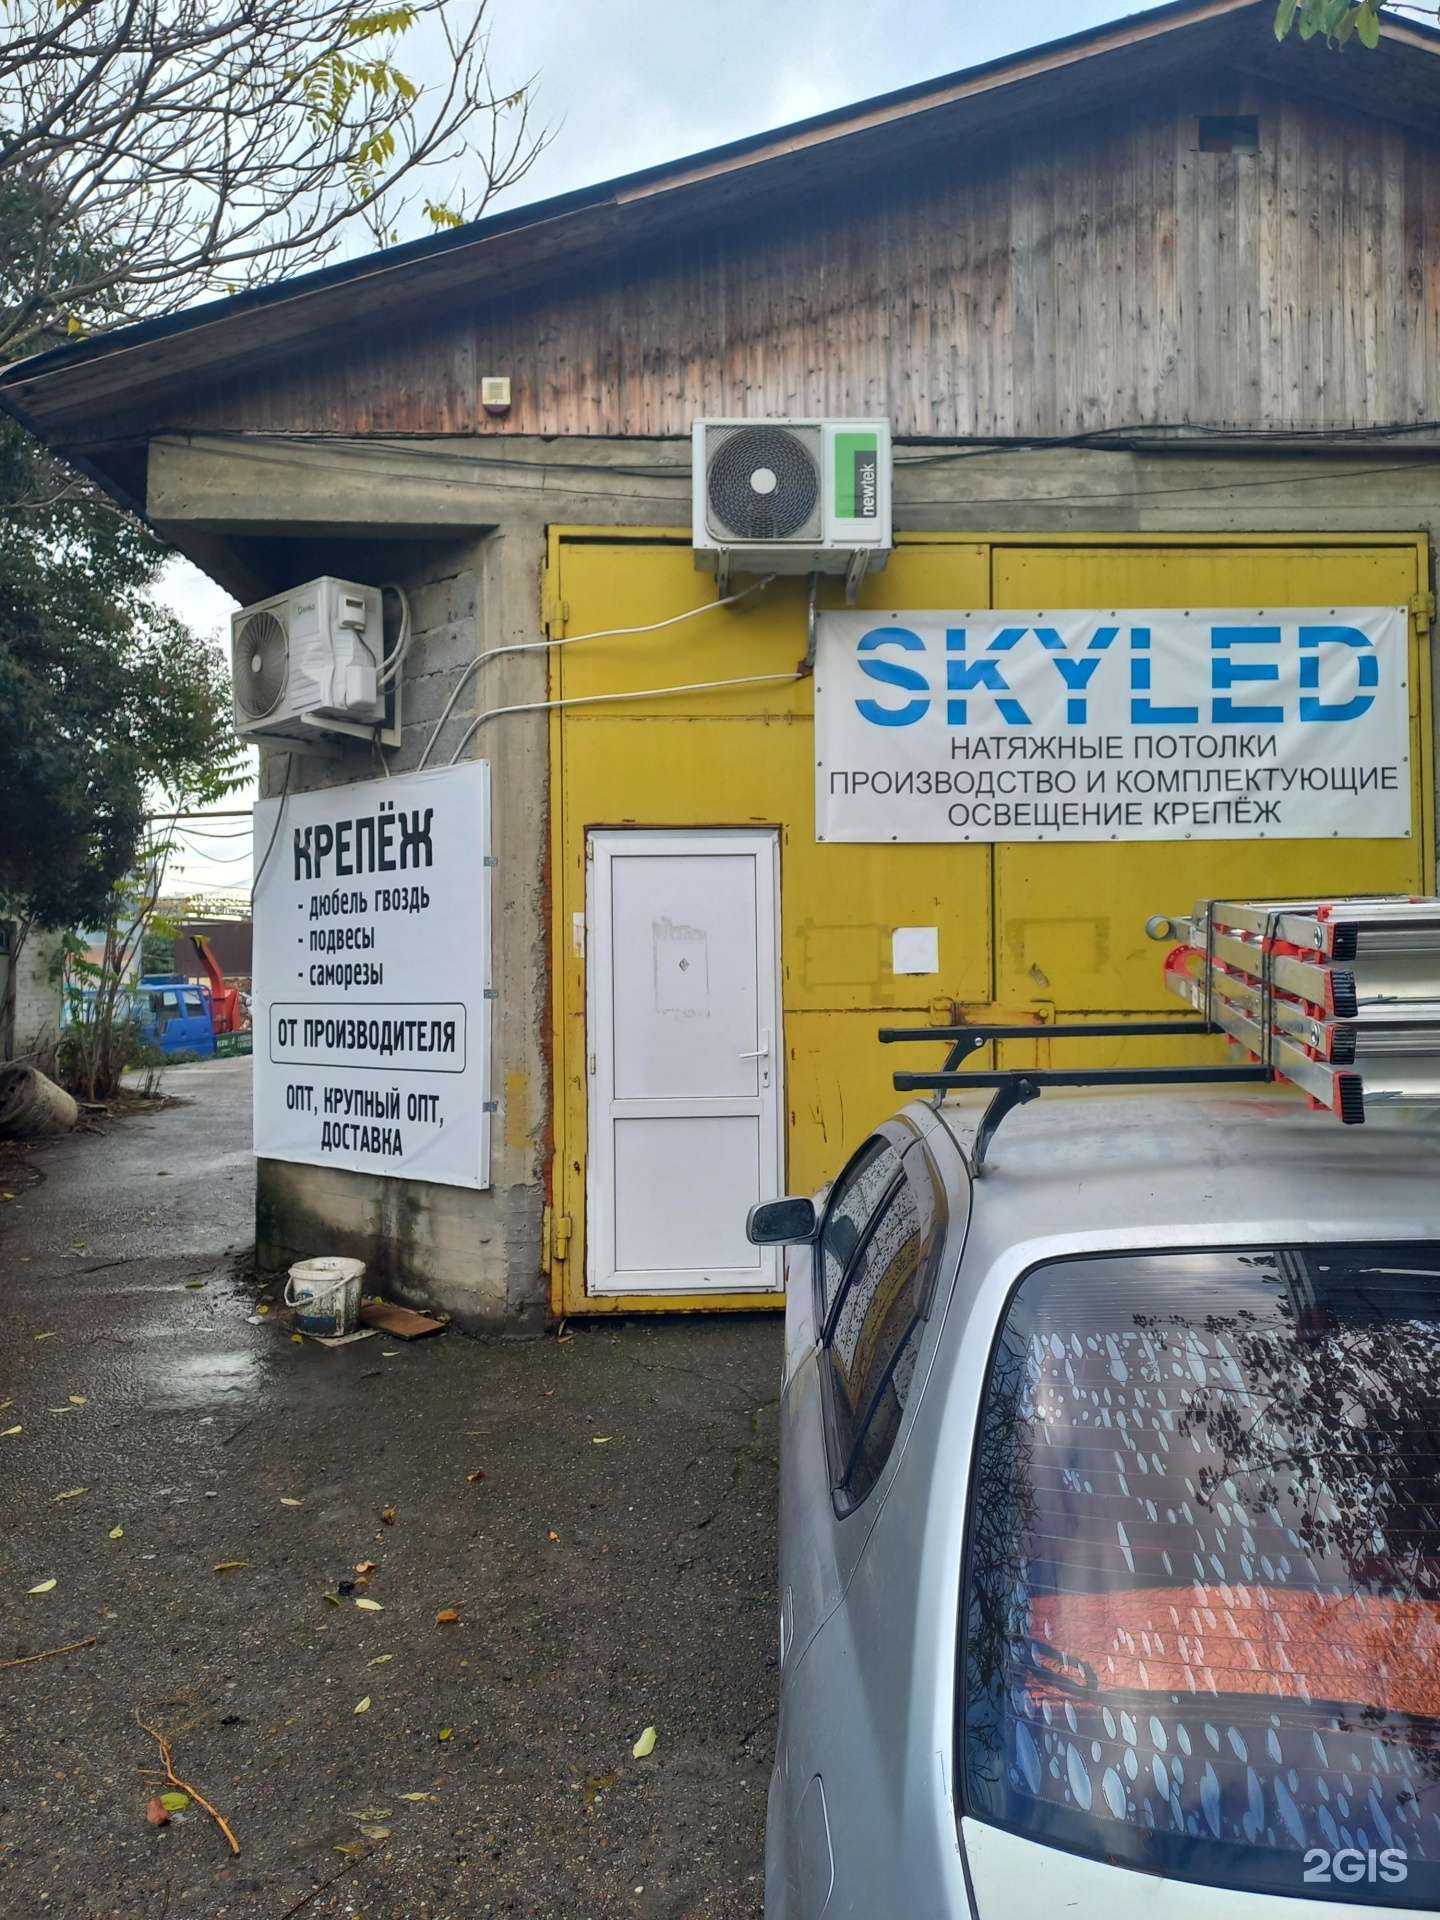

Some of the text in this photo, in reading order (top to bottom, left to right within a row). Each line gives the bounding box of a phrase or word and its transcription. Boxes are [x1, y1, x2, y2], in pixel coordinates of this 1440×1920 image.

[859, 462, 875, 516] newtek
[855, 625, 1379, 728] SKYLED
[950, 733, 1278, 761] НАТЯЖНЫЕ ПОТОЛКИ
[829, 765, 1400, 798] ПРОИЗВОДСТВО И КОМПЛЕКТУЮЩИЕ
[947, 795, 1282, 832] ОСВЕЩЕНИЕ КРЕПЁЖ
[293, 801, 434, 881] КРЕПЁЖ
[309, 887, 368, 921] дюбель
[374, 885, 430, 914] гвоздь
[309, 925, 375, 953] подвесы
[309, 961, 384, 992] саморезы
[278, 1018, 456, 1056] ОТ ПРОИЗВОДИТЕЛЯ
[286, 1084, 444, 1129] ОПТ, КРУПНЫЙ ОПТ,
[320, 1120, 403, 1157] ДОСТАВКА
